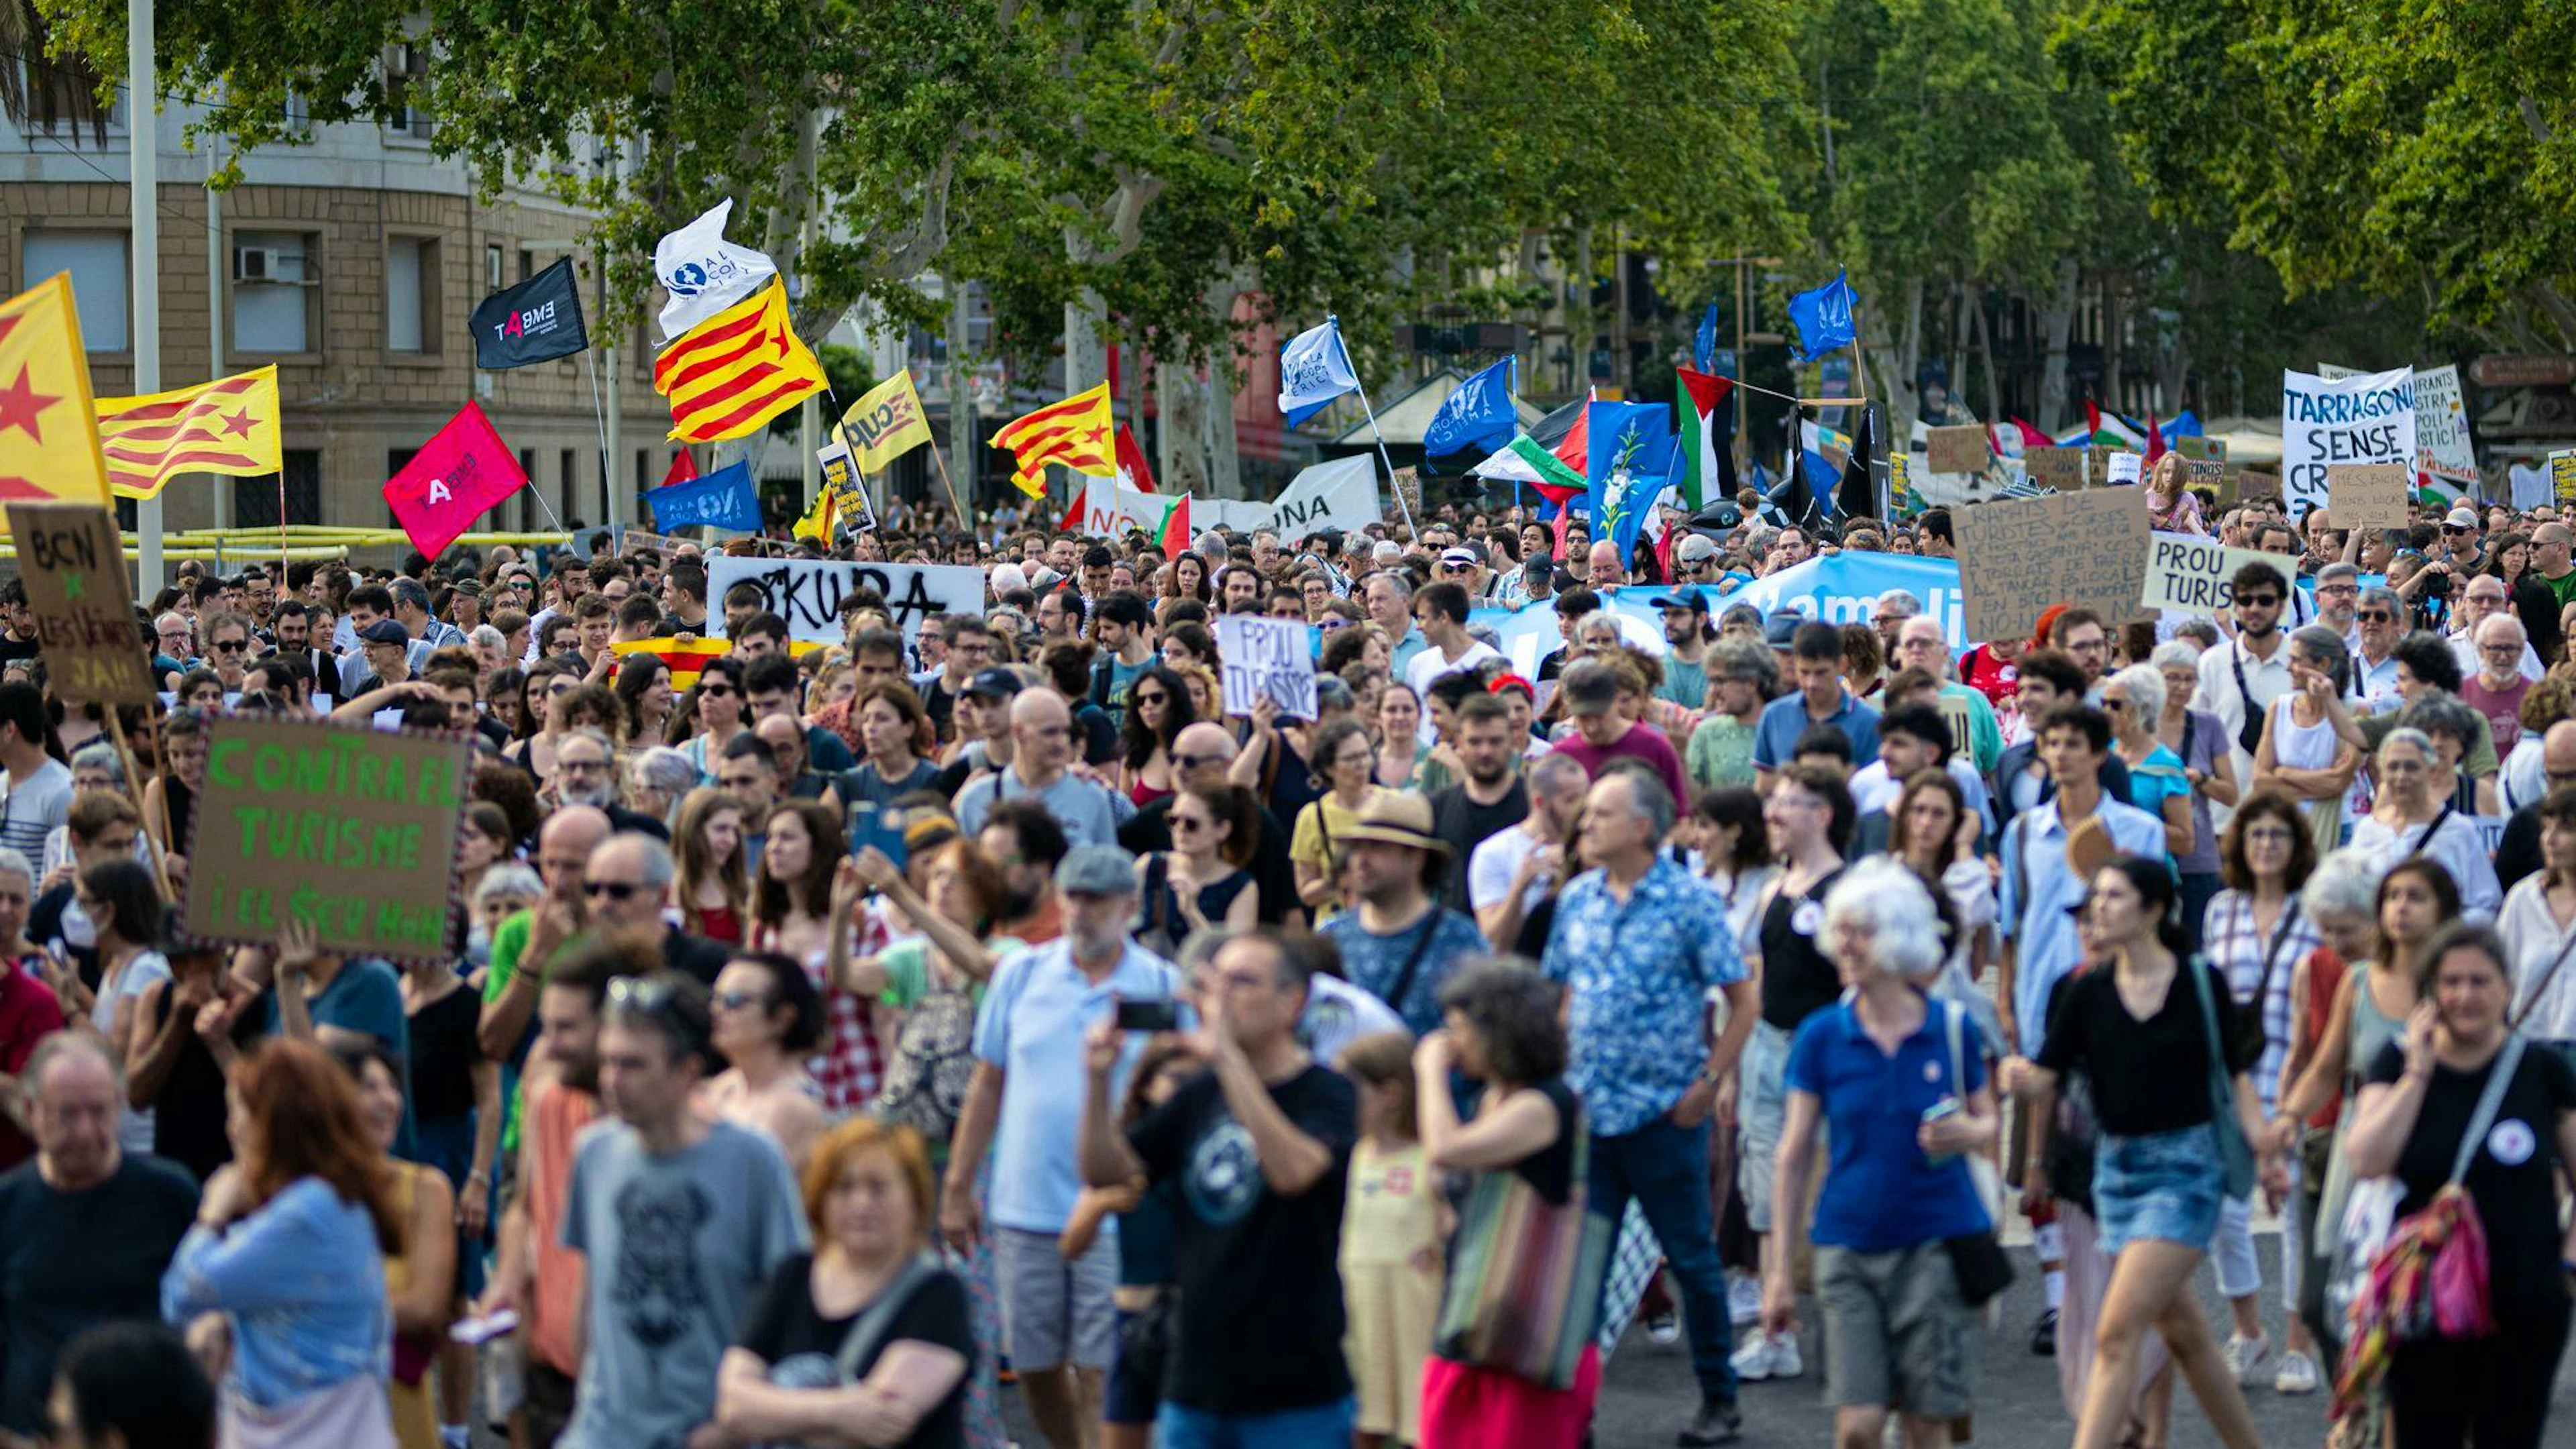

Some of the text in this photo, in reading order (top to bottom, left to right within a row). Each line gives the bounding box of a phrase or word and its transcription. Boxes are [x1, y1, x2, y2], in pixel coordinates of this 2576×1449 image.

[2308, 425, 2403, 461] SENSE
[31, 523, 95, 570] BCN
[2156, 542, 2224, 575] PROU
[209, 732, 461, 809] CONTRA EL
[237, 887, 276, 928] EL
